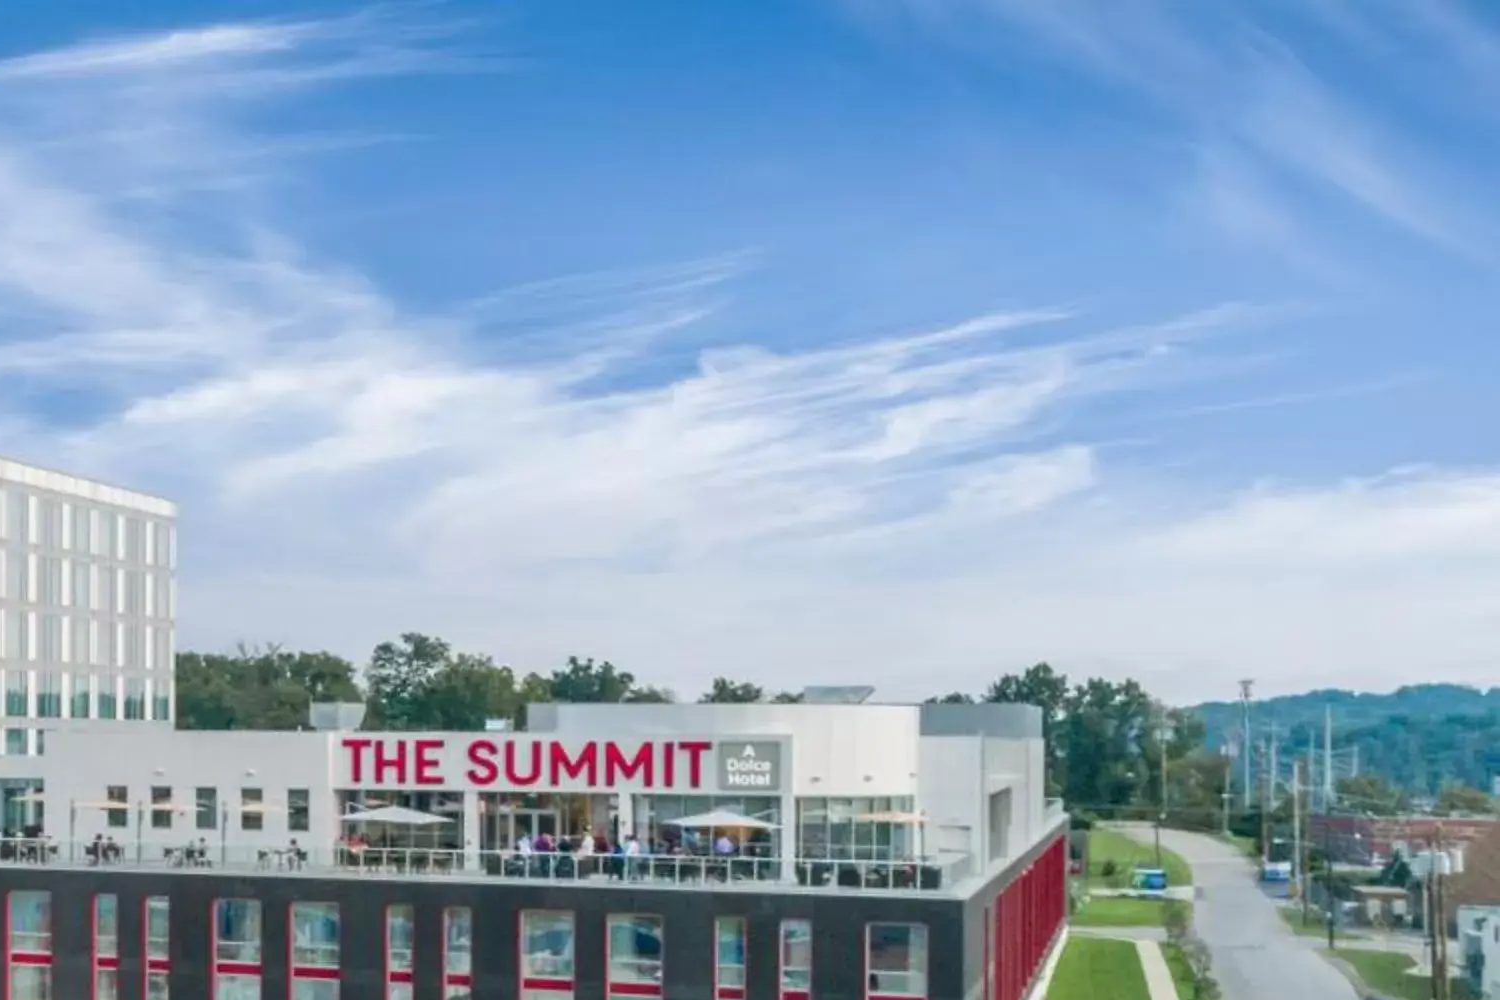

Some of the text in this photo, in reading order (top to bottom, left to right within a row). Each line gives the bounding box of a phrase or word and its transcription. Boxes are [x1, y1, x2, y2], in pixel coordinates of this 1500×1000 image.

[741, 744, 756, 758] A
[342, 739, 713, 789] THE SUMMIT
[728, 772, 771, 786] Hotel
